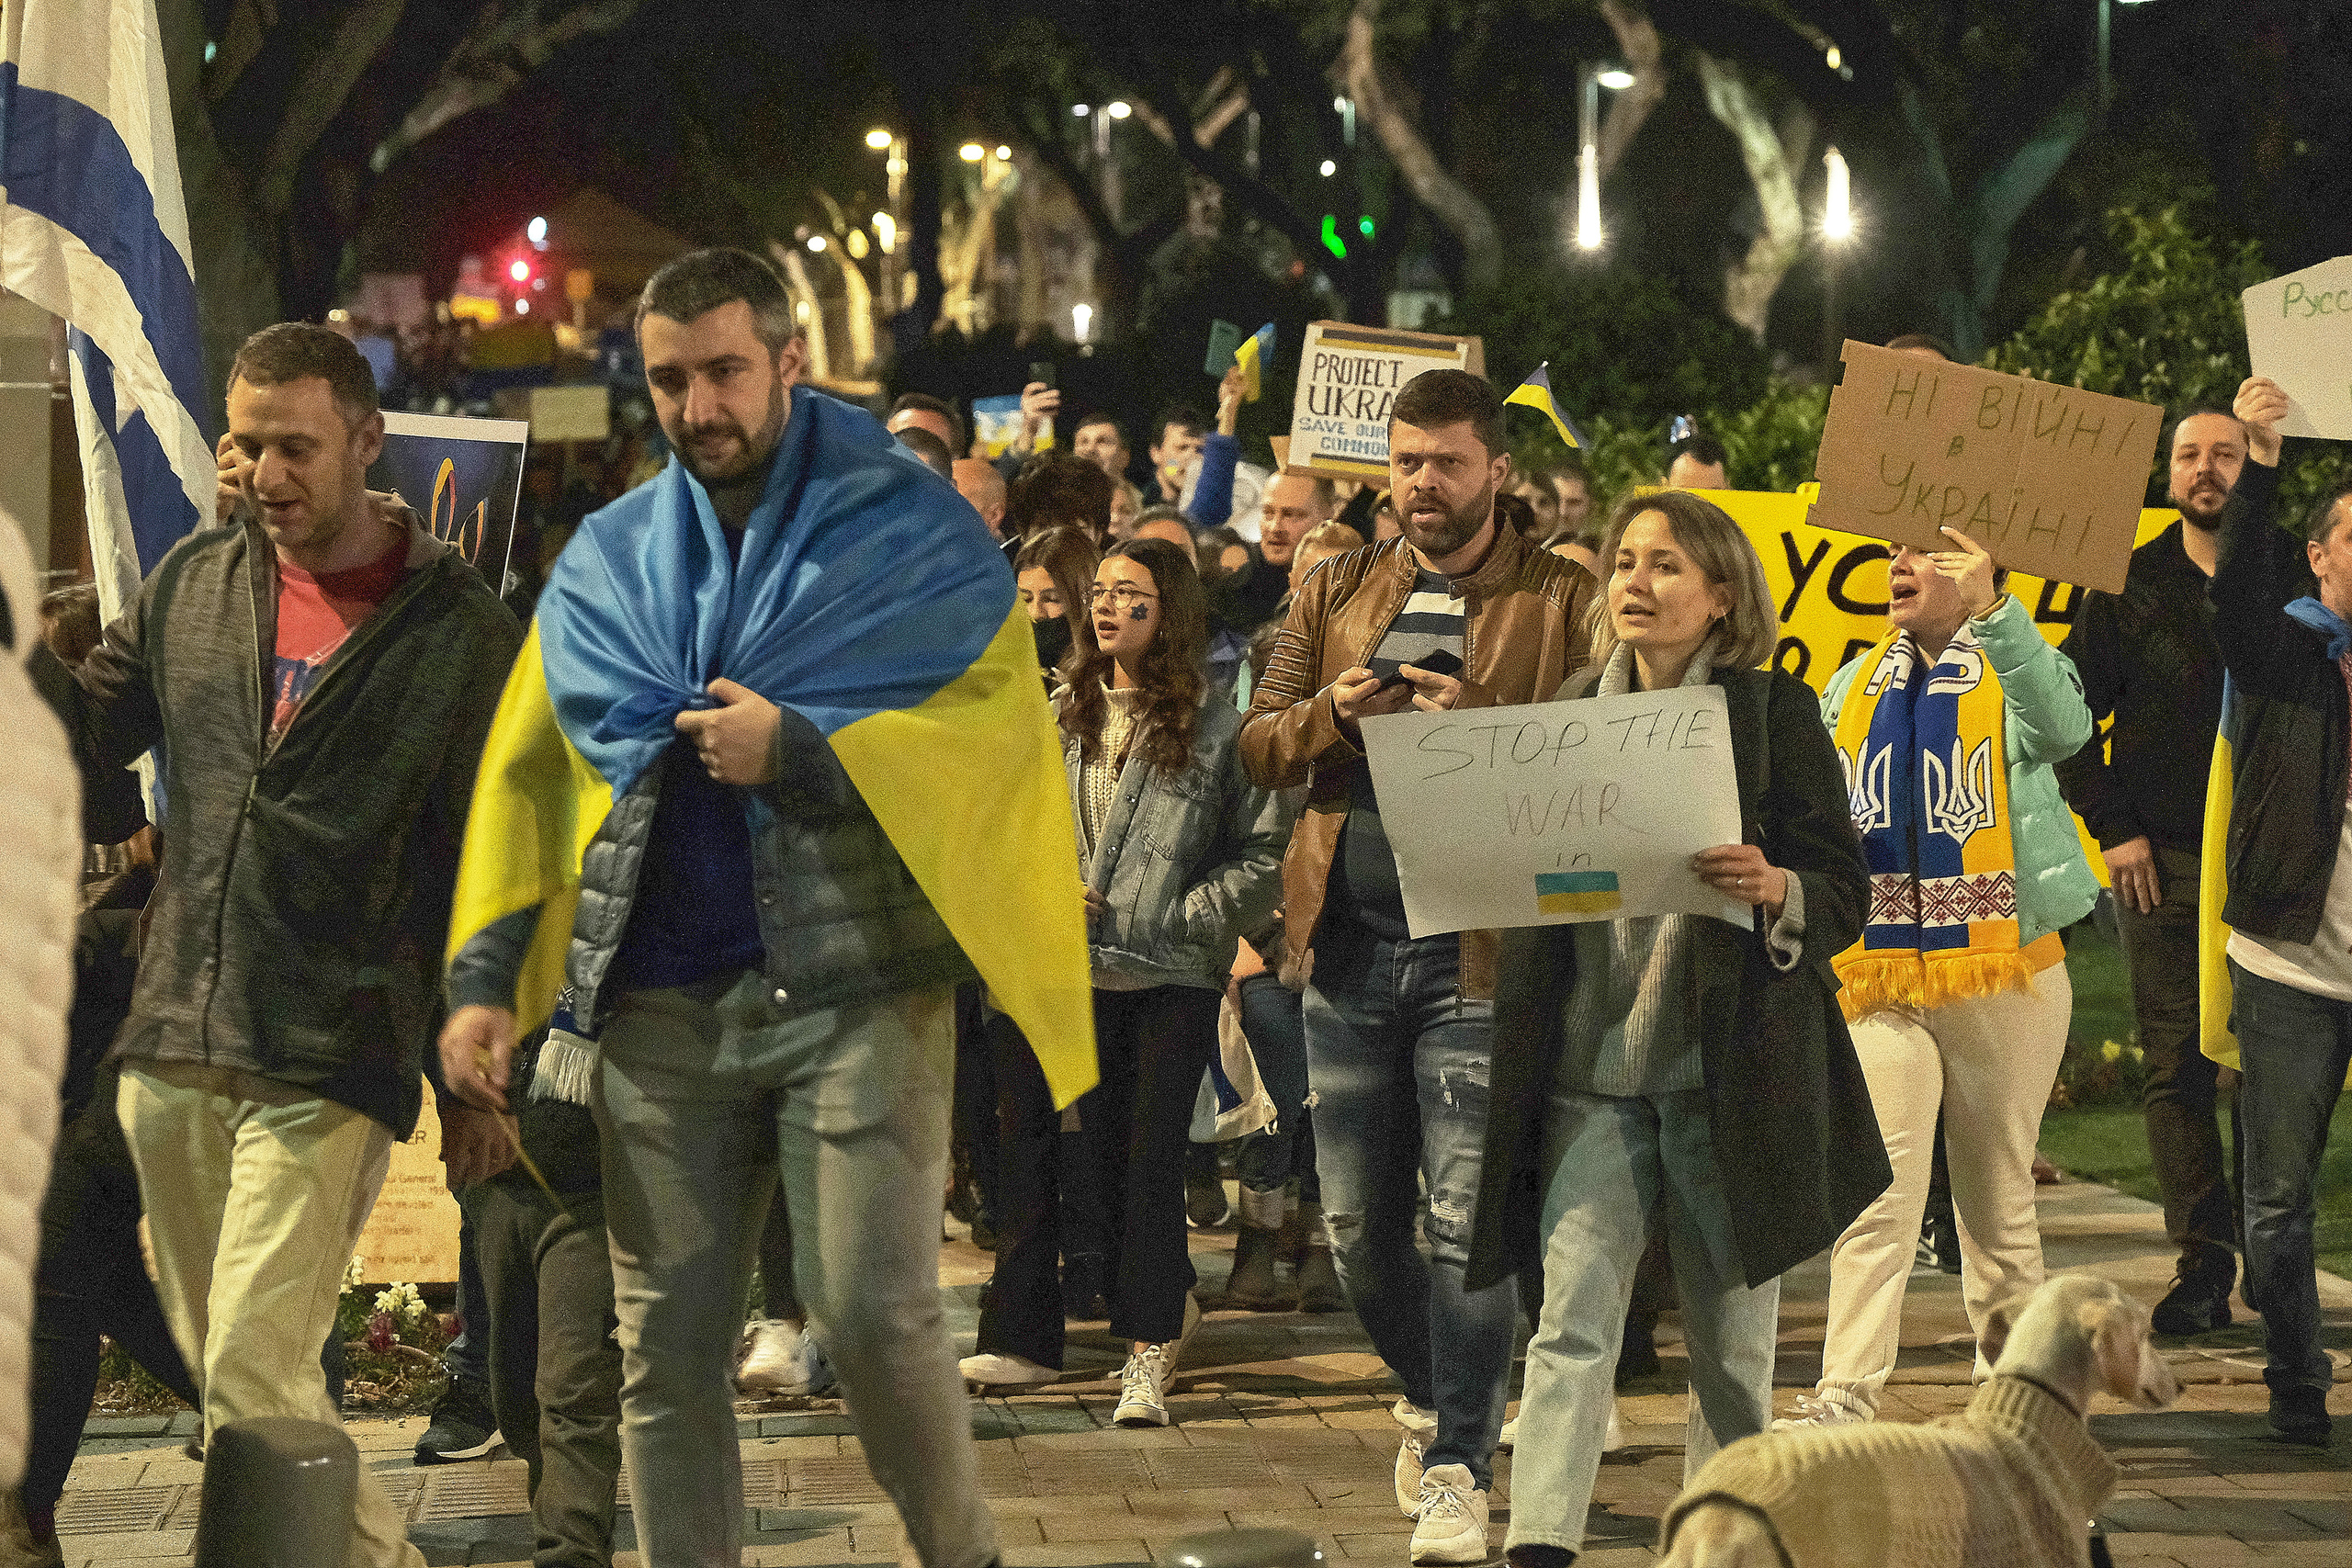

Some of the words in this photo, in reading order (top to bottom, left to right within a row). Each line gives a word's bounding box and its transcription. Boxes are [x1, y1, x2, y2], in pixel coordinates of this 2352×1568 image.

[1312, 352, 1403, 389] PROTECT
[1298, 416, 1346, 436] SAVE
[1356, 423, 1388, 439] OUR
[1417, 720, 1589, 780] STOP
[1607, 709, 1714, 751] THE
[1506, 782, 1648, 837] WAR
[1555, 852, 1591, 867] in
